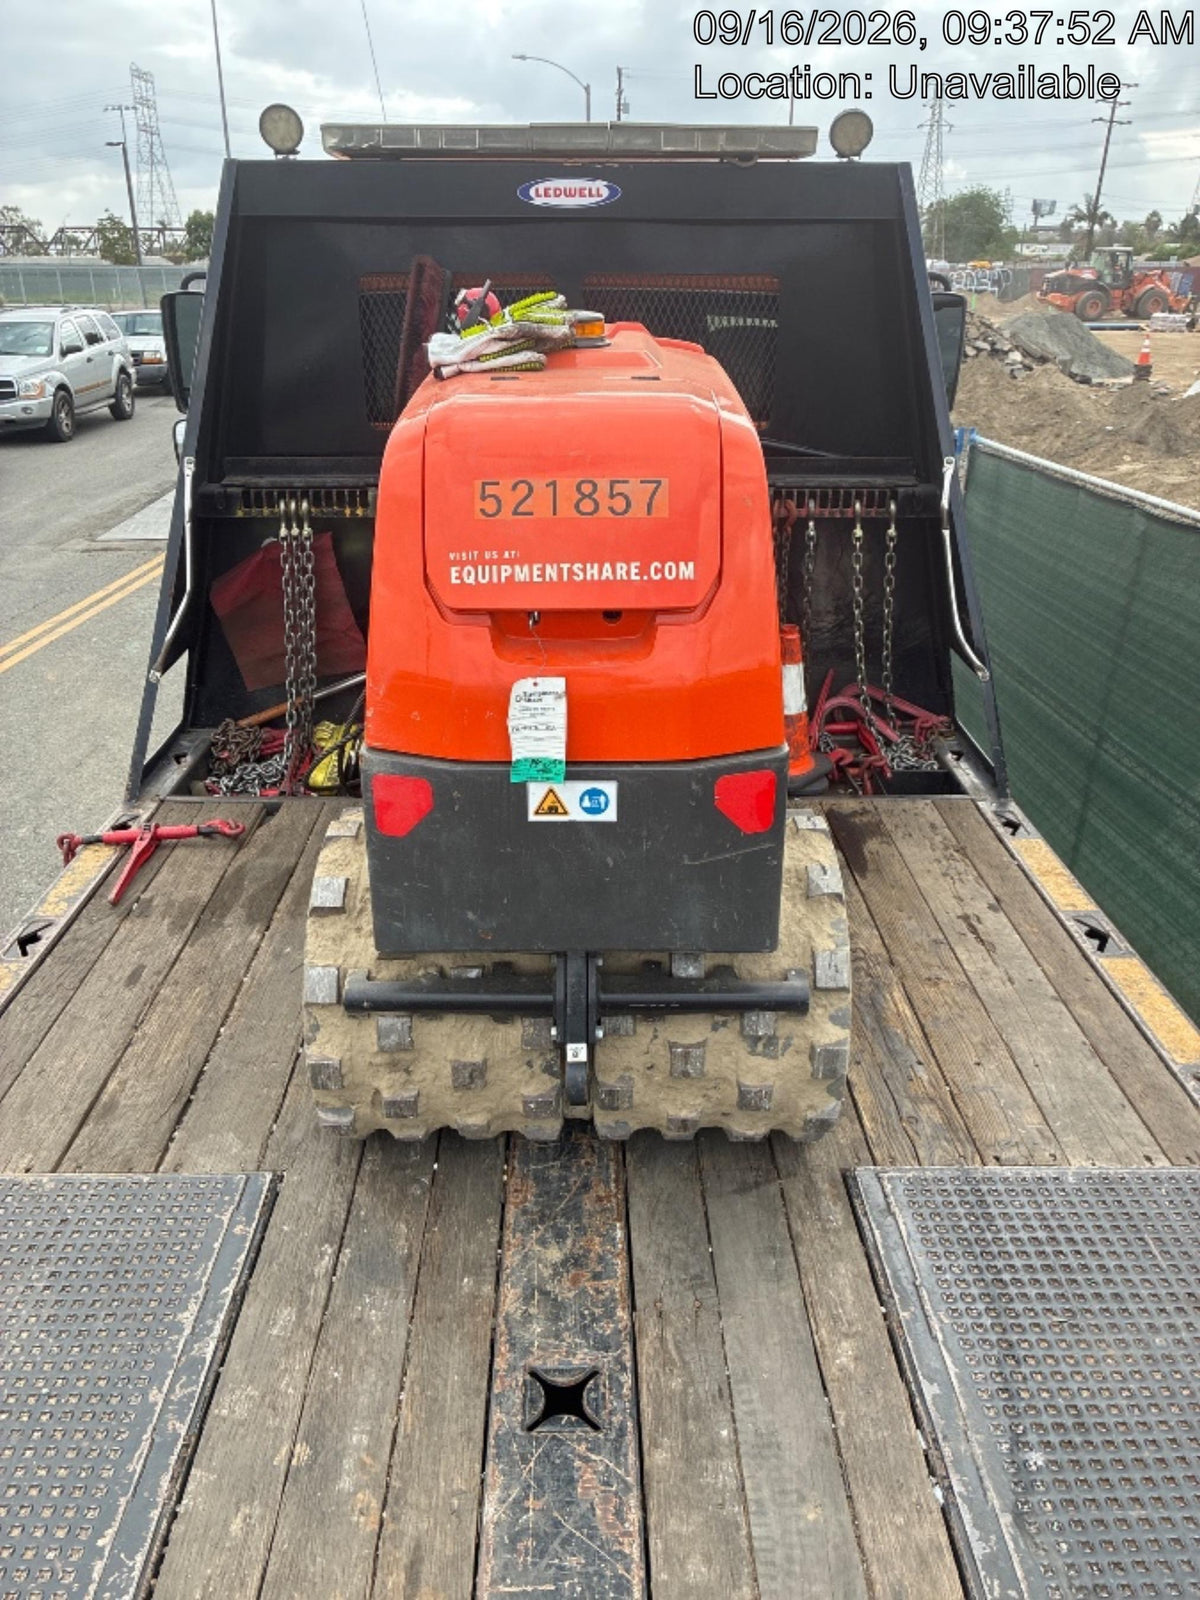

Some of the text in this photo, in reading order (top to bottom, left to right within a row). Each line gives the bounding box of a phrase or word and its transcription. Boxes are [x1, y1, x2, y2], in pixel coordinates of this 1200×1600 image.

[535, 187, 603, 198] LEDWELL
[479, 479, 662, 517] 521857
[449, 550, 520, 560] VISIT US AT:
[450, 561, 695, 585] EQUIPMENTSHARE.COM
